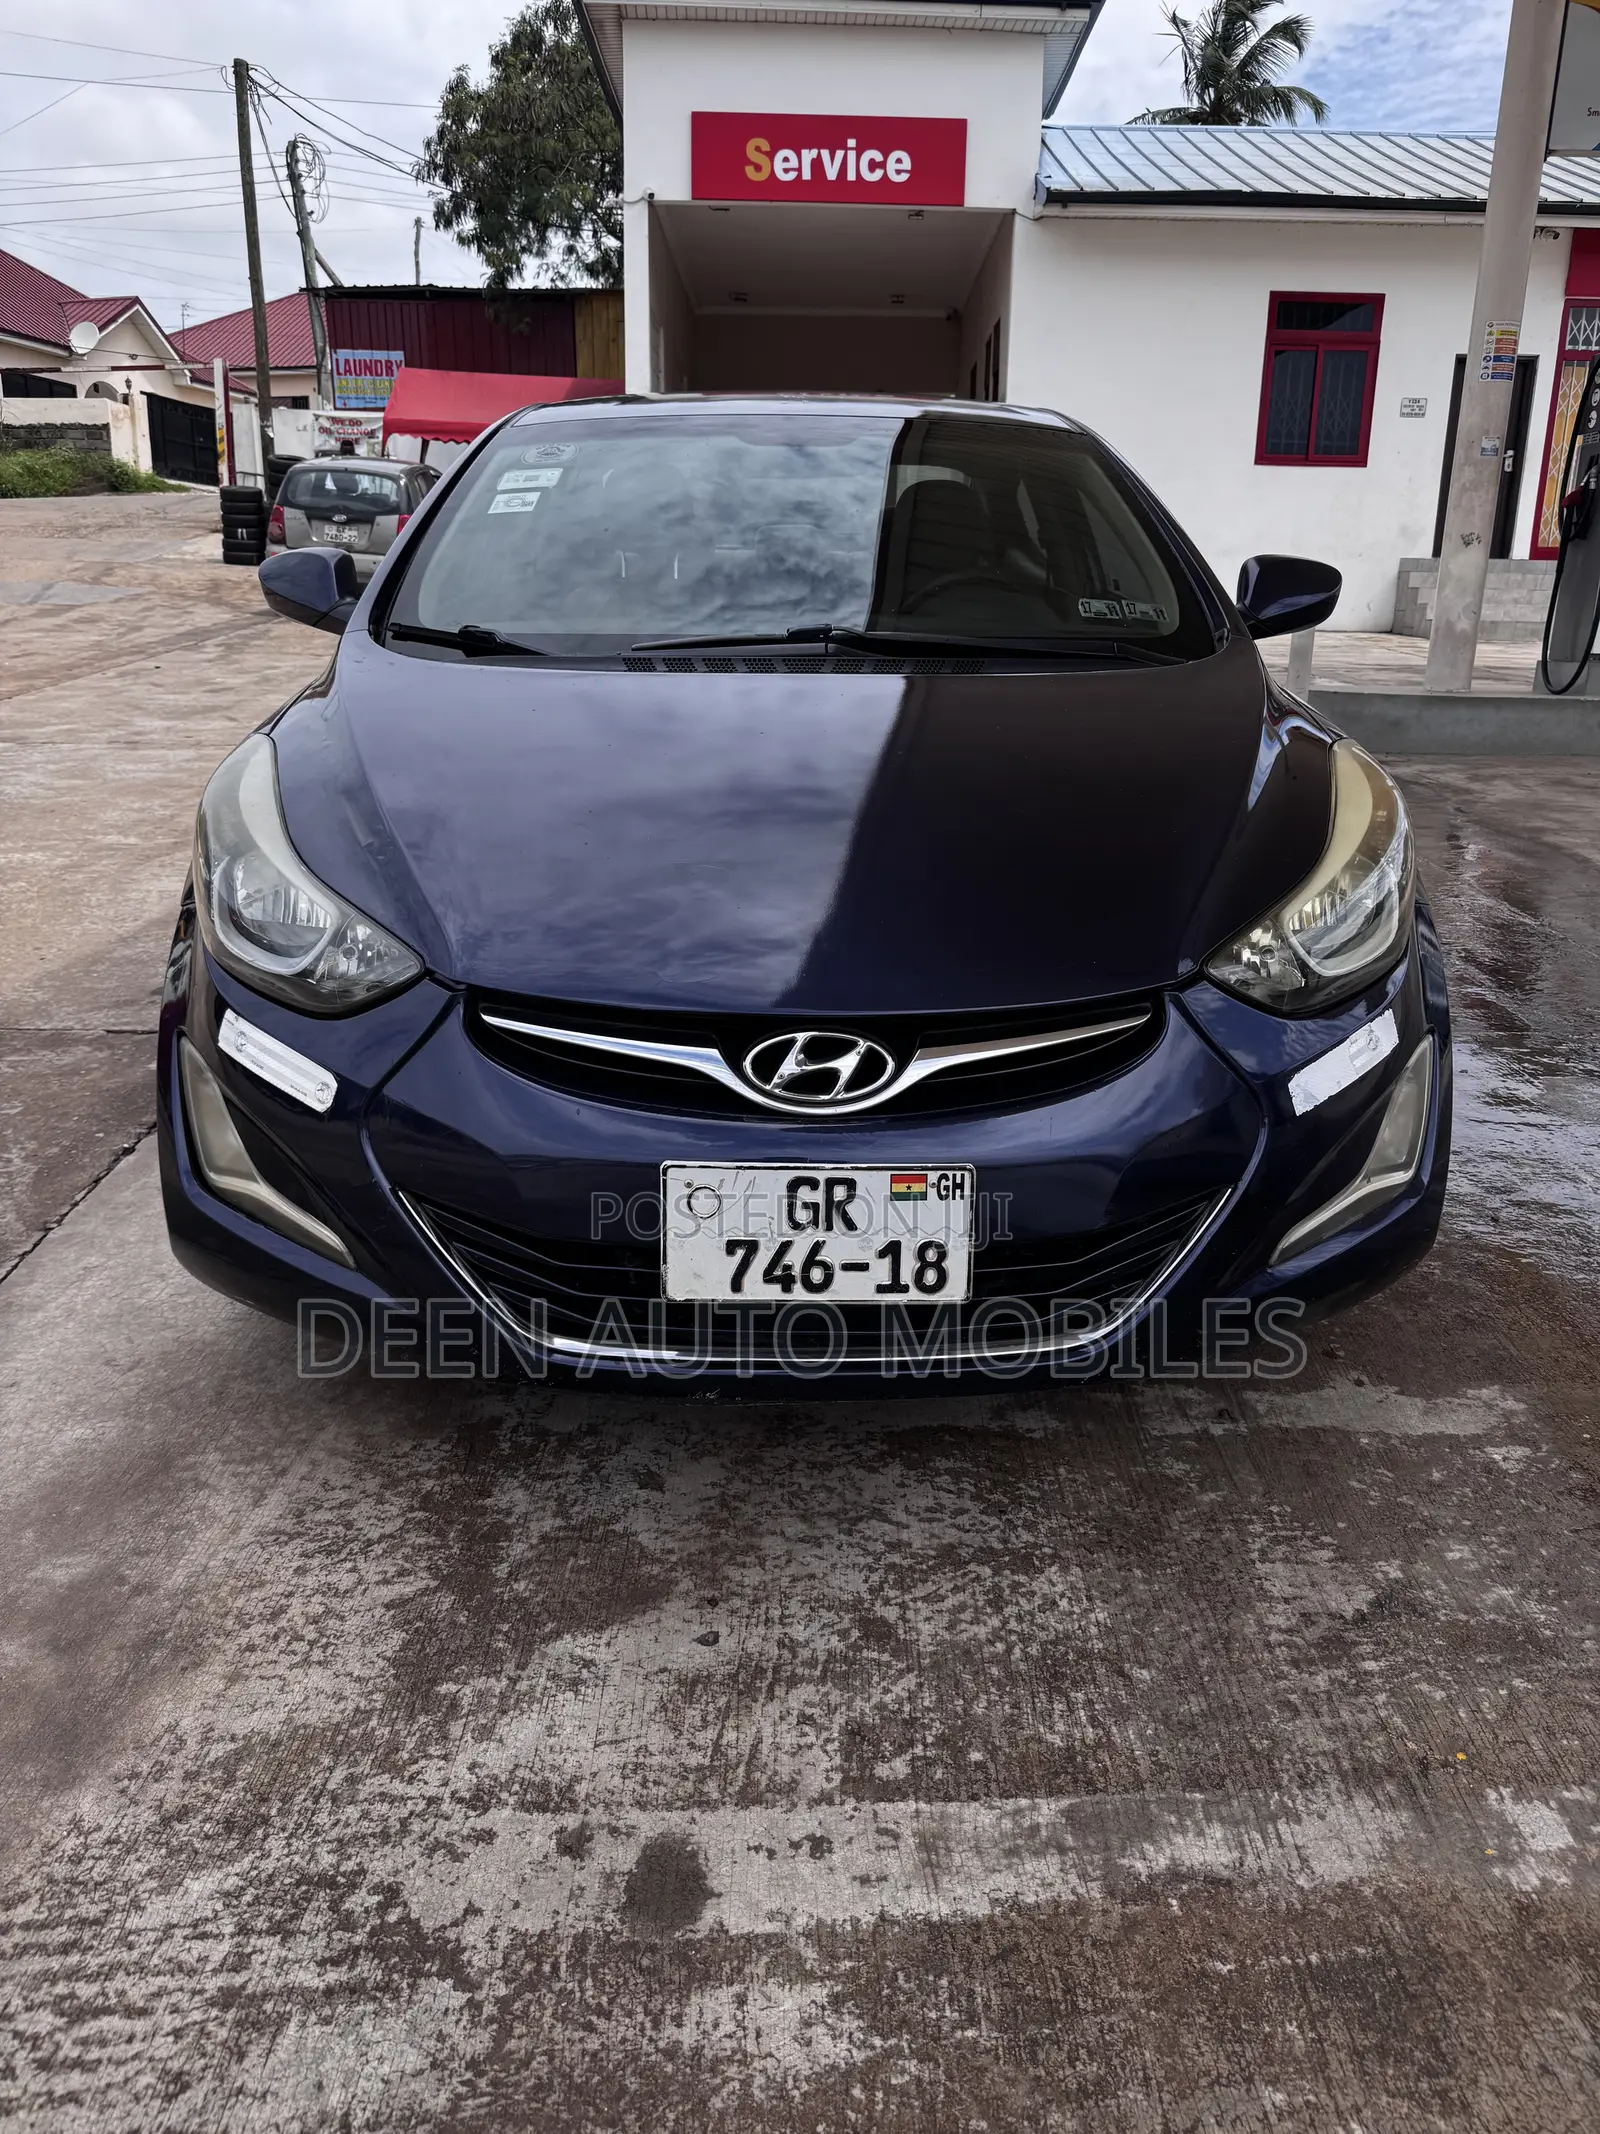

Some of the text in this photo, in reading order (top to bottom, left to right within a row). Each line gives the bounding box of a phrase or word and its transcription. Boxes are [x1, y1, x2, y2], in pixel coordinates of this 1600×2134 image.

[744, 137, 912, 183] Service
[335, 358, 403, 378] LAUNDRY
[335, 436, 361, 446] HE
[336, 427, 377, 437] CHANGE
[785, 1172, 966, 1233] GR GH
[724, 1237, 949, 1294] 746-18
